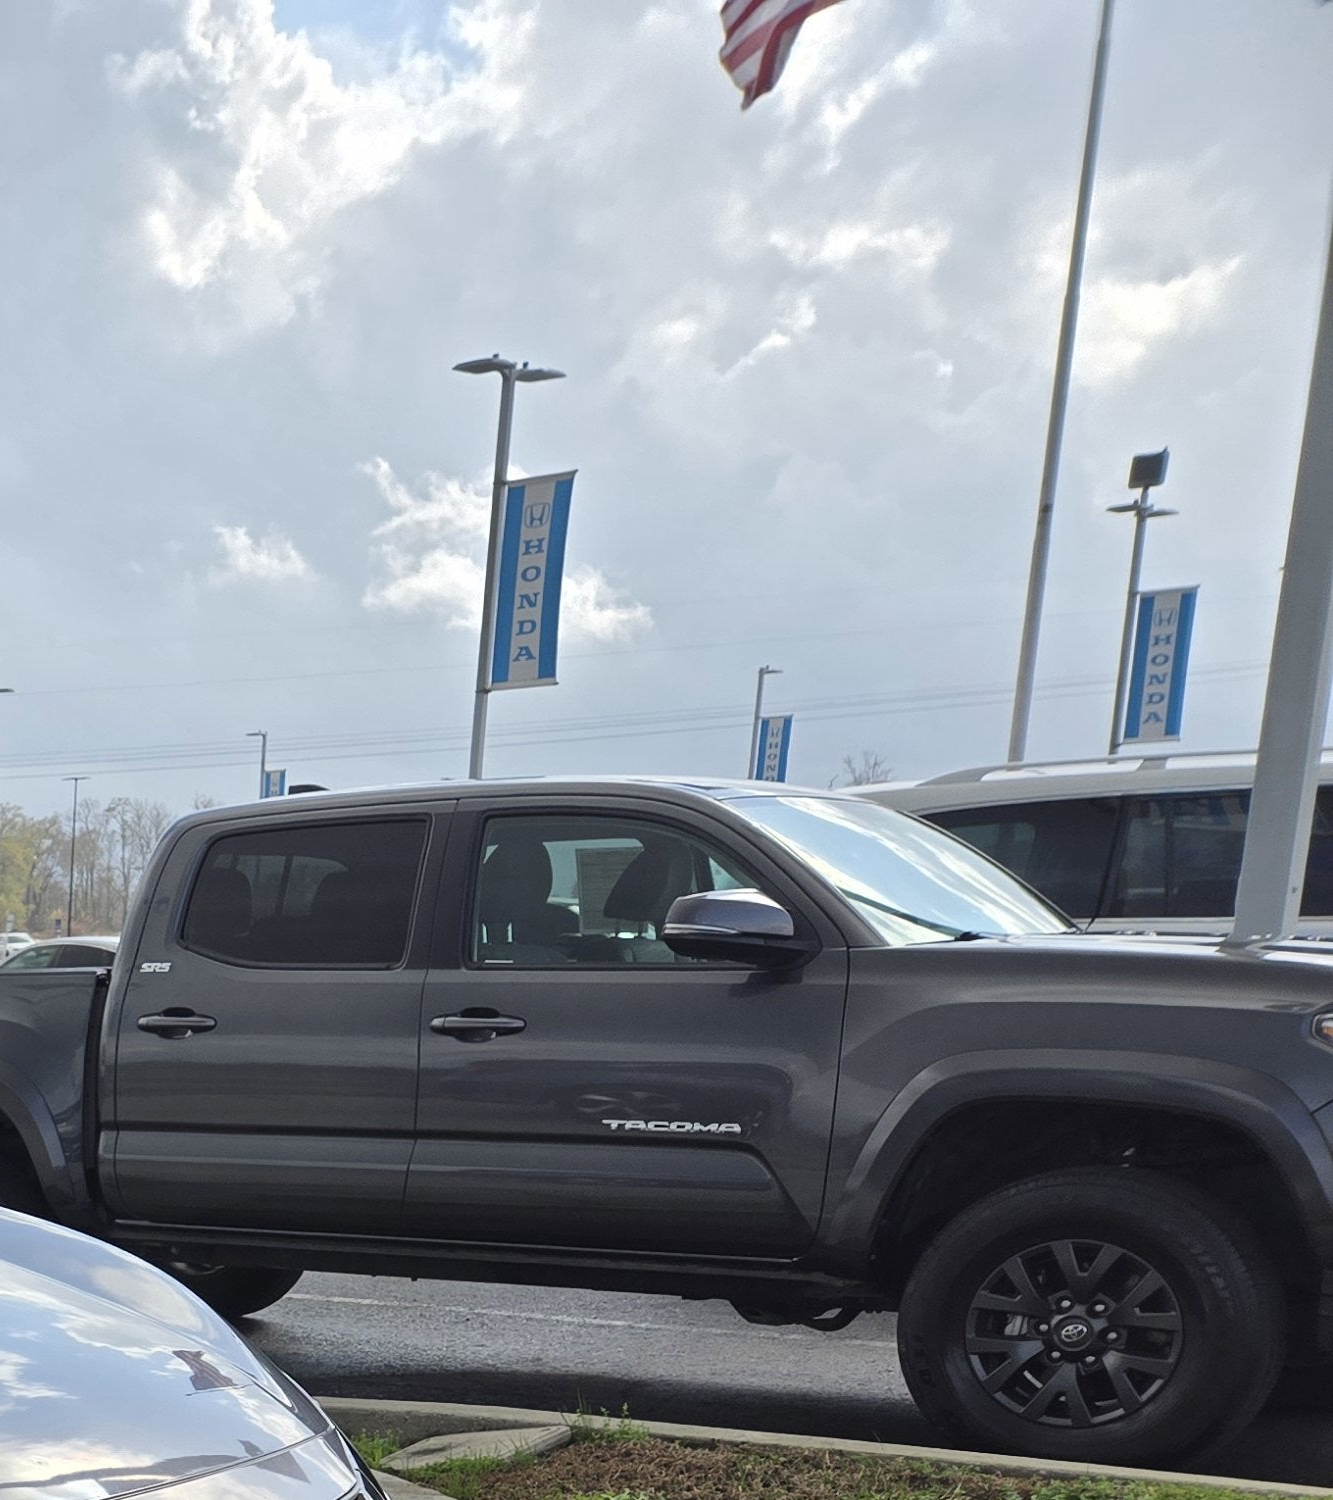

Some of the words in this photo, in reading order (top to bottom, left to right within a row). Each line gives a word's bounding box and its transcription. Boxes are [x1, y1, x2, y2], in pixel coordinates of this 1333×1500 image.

[513, 537, 545, 662] HONDA
[1142, 632, 1173, 725] HONDA
[765, 741, 779, 780] HON
[601, 1118, 742, 1134] TACOMA
